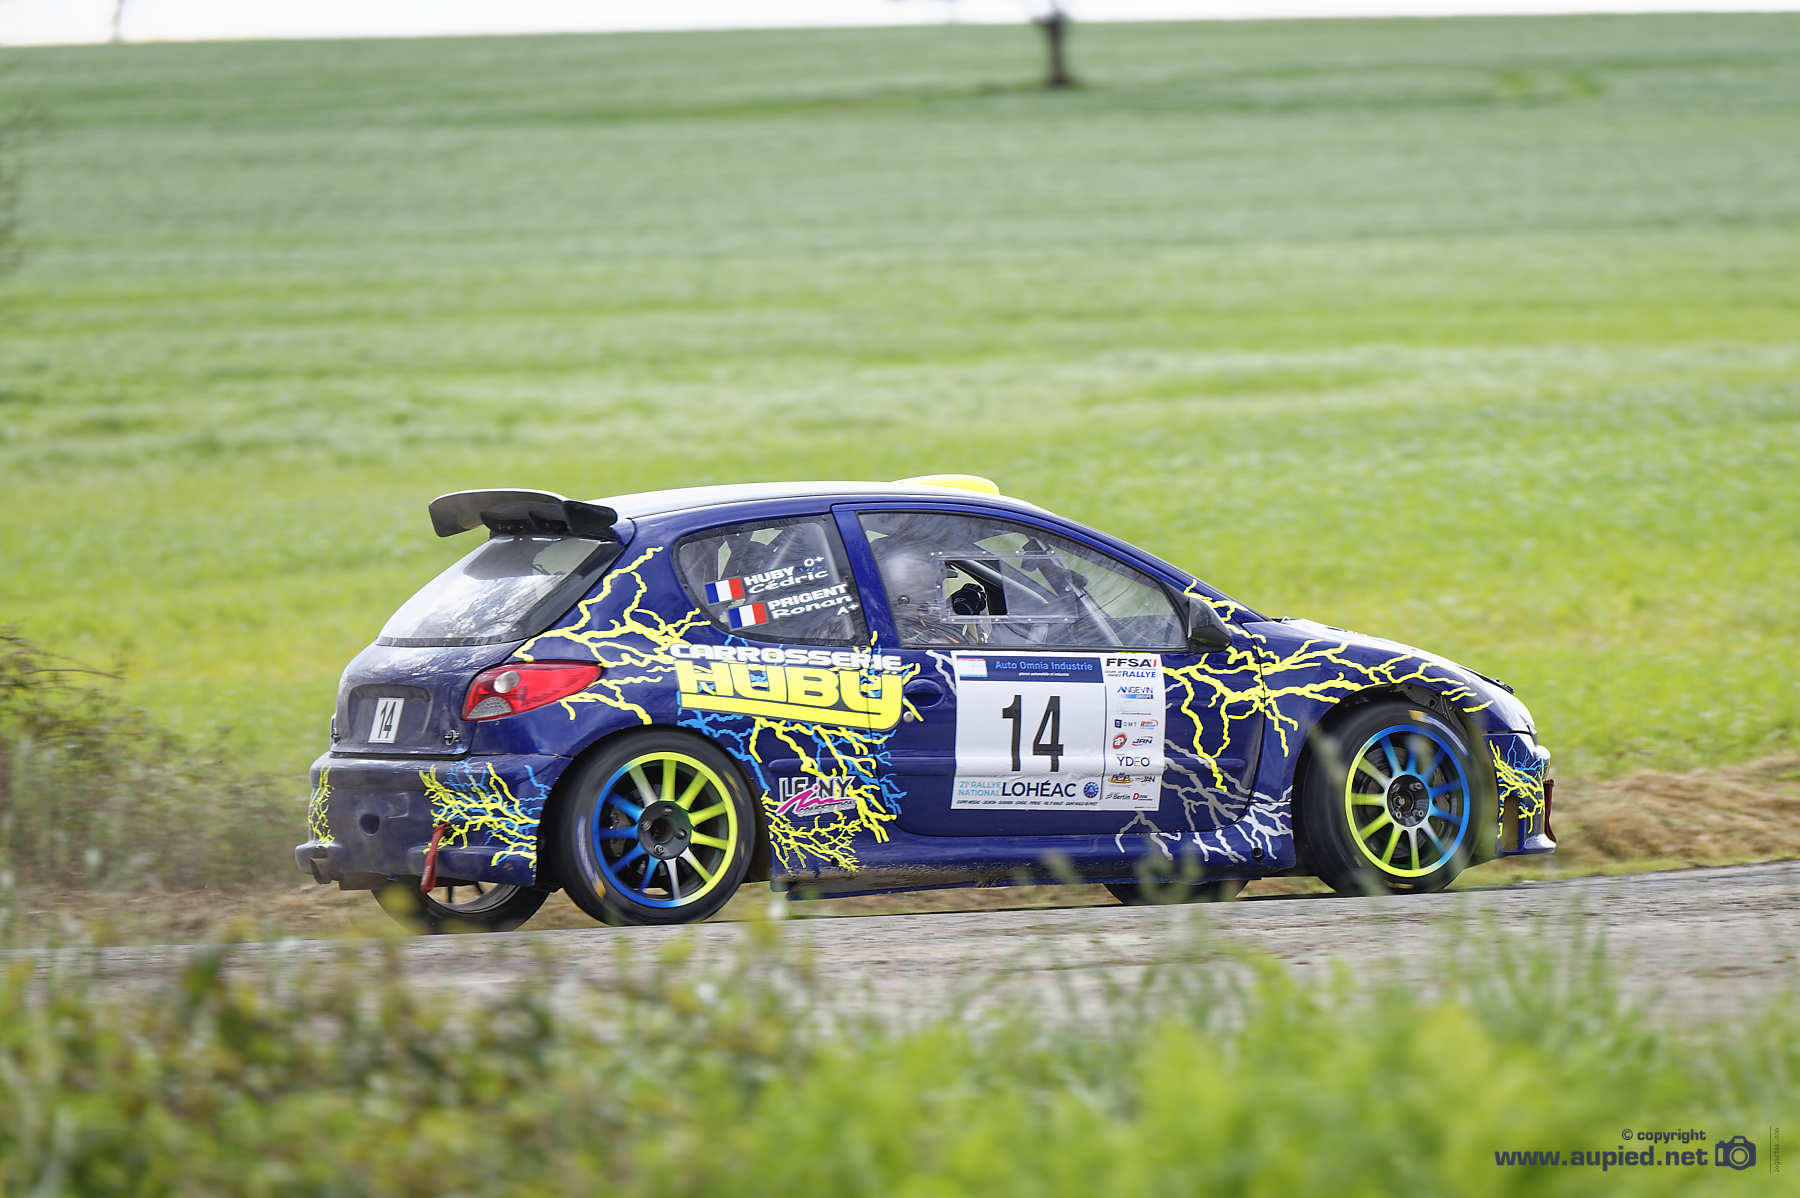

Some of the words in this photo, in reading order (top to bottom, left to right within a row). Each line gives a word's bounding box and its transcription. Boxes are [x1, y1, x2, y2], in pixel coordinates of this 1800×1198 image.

[745, 566, 794, 587] HUBY
[748, 570, 829, 594] Cédric
[767, 583, 848, 611] PRIGENT
[771, 595, 853, 619] Ronan
[837, 603, 860, 616] A+
[670, 643, 902, 671] CARROSSERIE
[995, 660, 1017, 670] Auto
[1019, 661, 1049, 671] Omnia
[1051, 661, 1093, 671] Industrie
[1106, 658, 1152, 668] FFSA
[1122, 670, 1156, 679] RALLYE
[674, 659, 903, 731] HUBY
[378, 701, 397, 739] 14
[1001, 694, 1064, 772] 14
[959, 789, 1001, 797] NATIONAL
[1002, 780, 1077, 798] LOHÉAC
